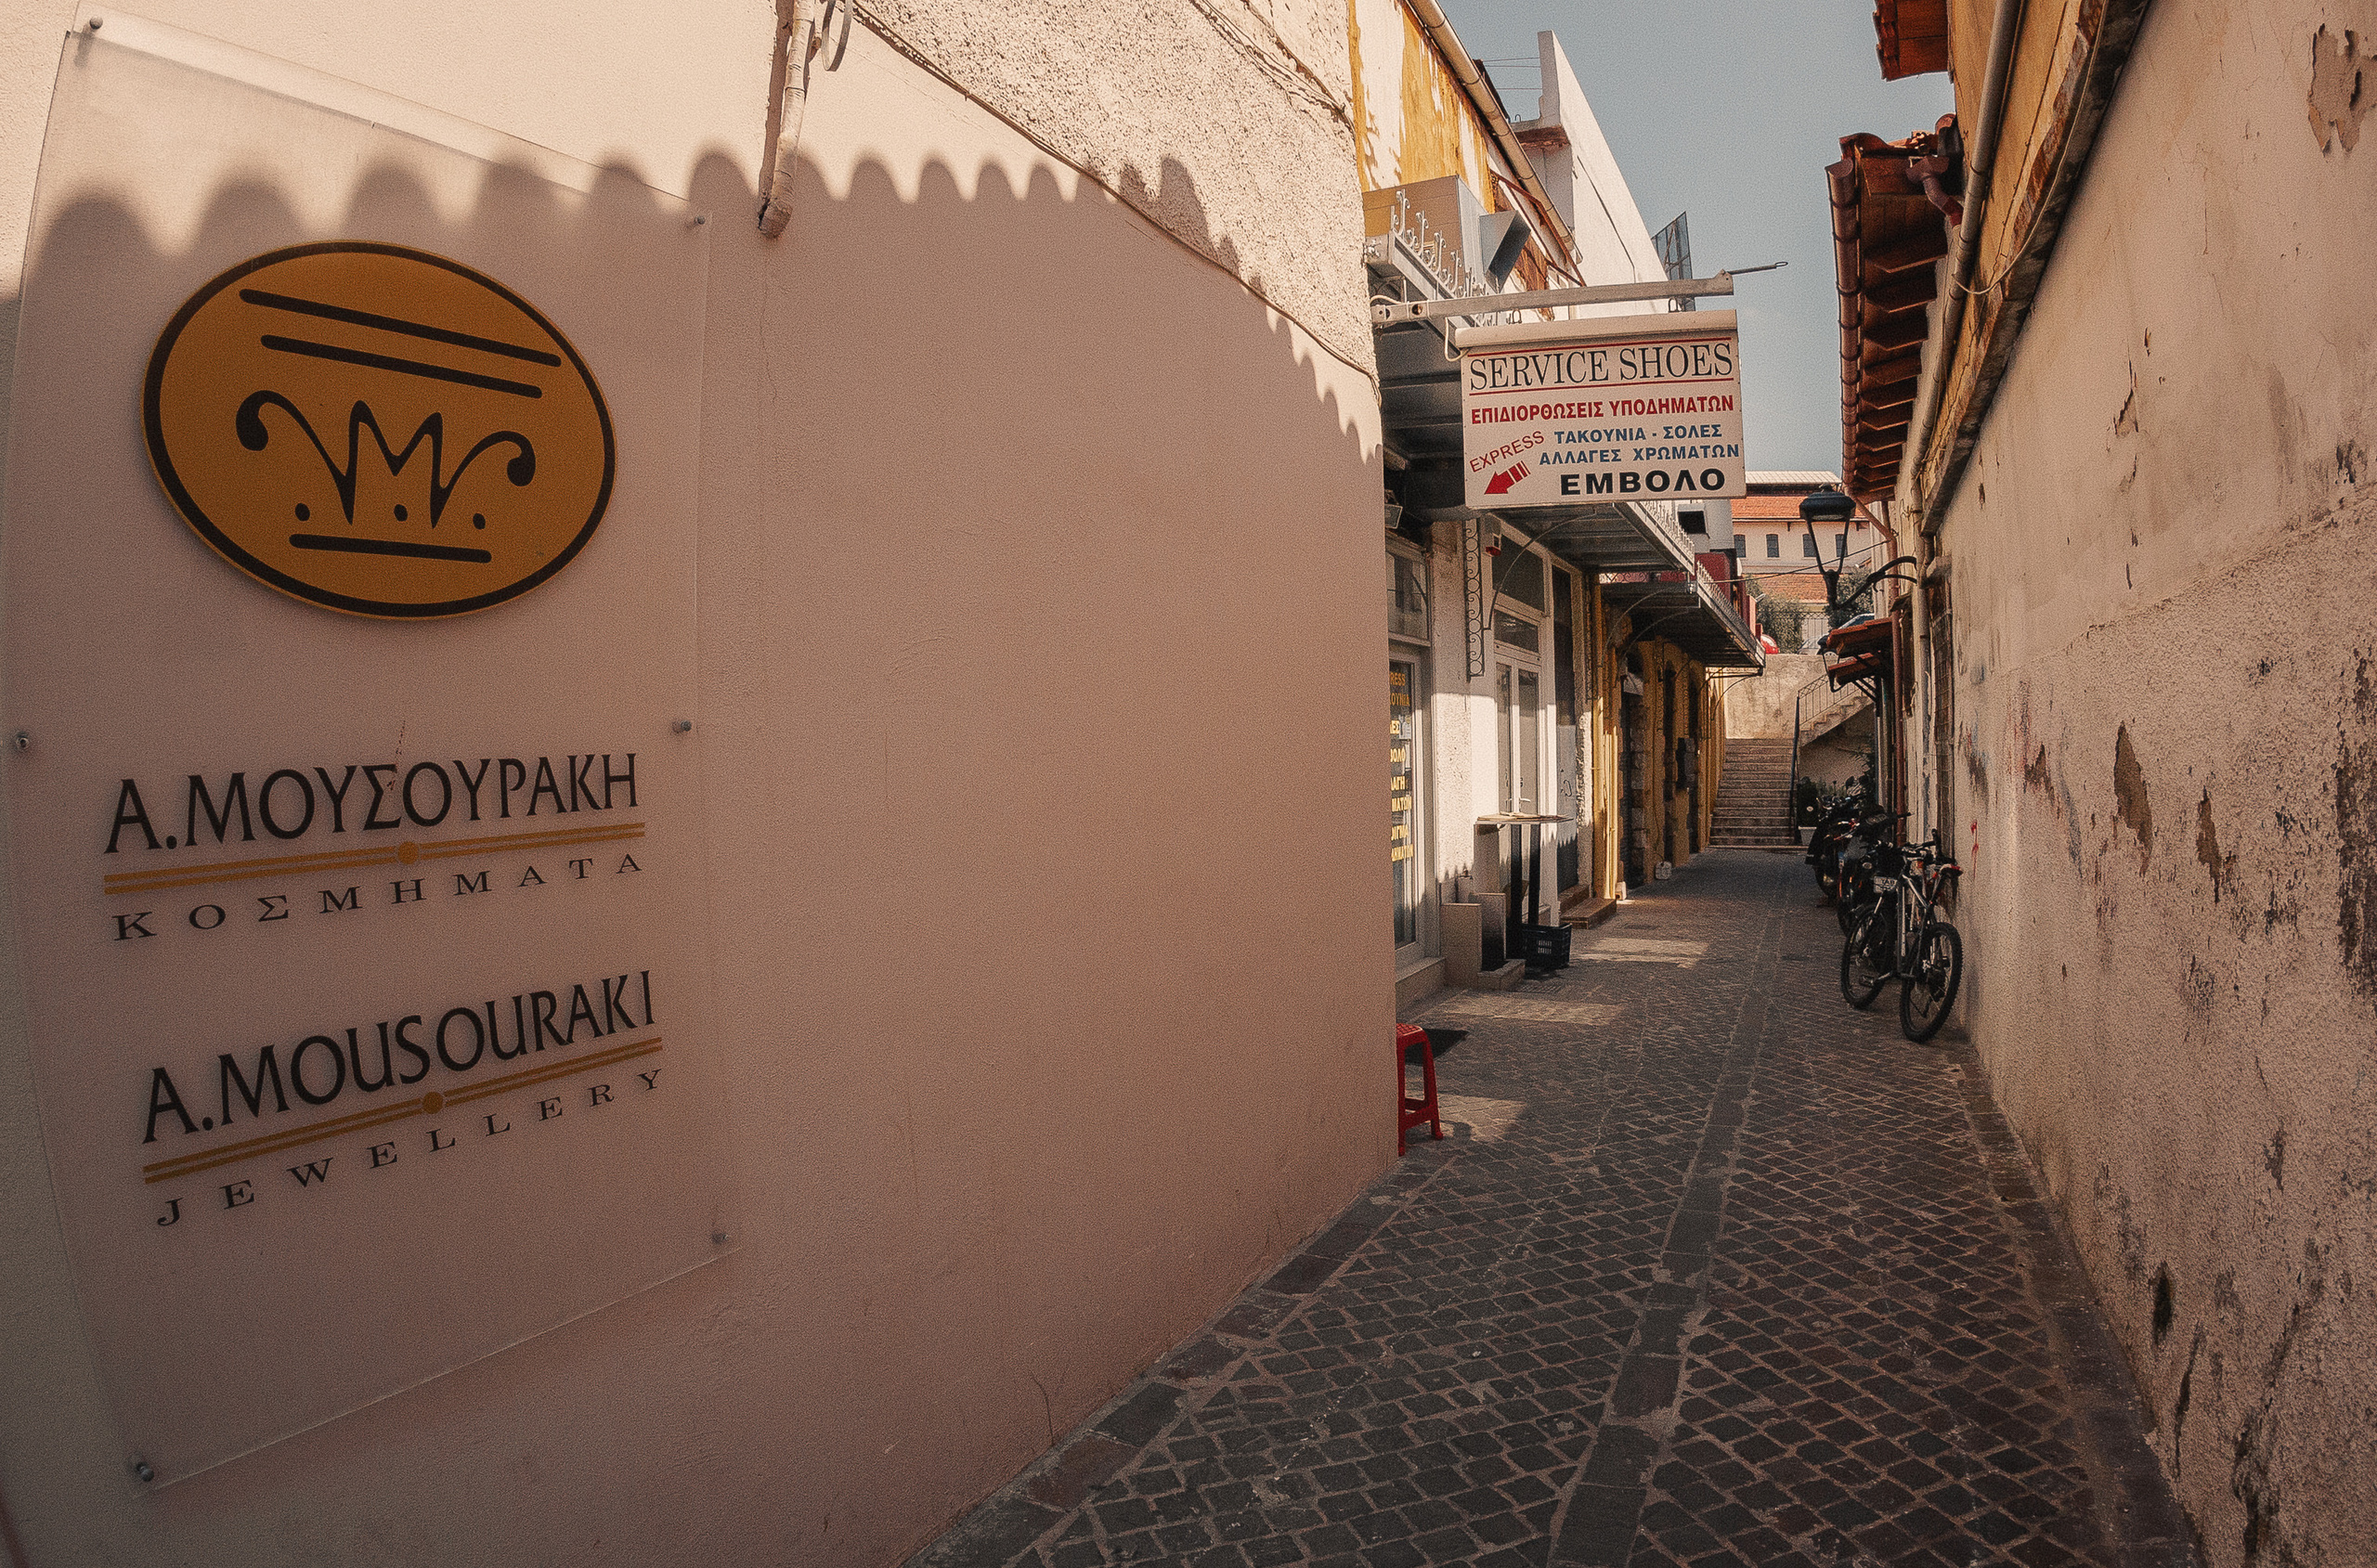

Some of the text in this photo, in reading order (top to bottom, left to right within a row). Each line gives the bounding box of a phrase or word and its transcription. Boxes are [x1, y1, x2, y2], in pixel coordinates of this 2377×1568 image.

[1470, 343, 1733, 391] SERVICE SHOES
[1472, 395, 1734, 424] ΕΠΙΔΙΟΡΘΩΣΕΙΣ ΥΠΟΔΗΜΑΤΩΝ
[1469, 431, 1545, 473] EXPRESS
[1539, 444, 1739, 466] ΑΛΛΑΓΕΣ ΧΡΩΜΑΤΩΝ
[1553, 427, 1646, 445] ΤΑΚΟΥΝΙΑ
[1663, 423, 1722, 439] ΣΟΛΕΣ
[1561, 468, 1726, 497] ΕΜΒΟΛΟ
[1389, 672, 1406, 687] RESS
[103, 753, 639, 854] Α.ΜΟΥΣΟΥΡΑΚΗ
[111, 852, 643, 941] ΚΟΣΜΗΜΑΤΑ
[142, 970, 656, 1144] A.MOUSOURAKI
[156, 1069, 663, 1227] JEWELLERY
